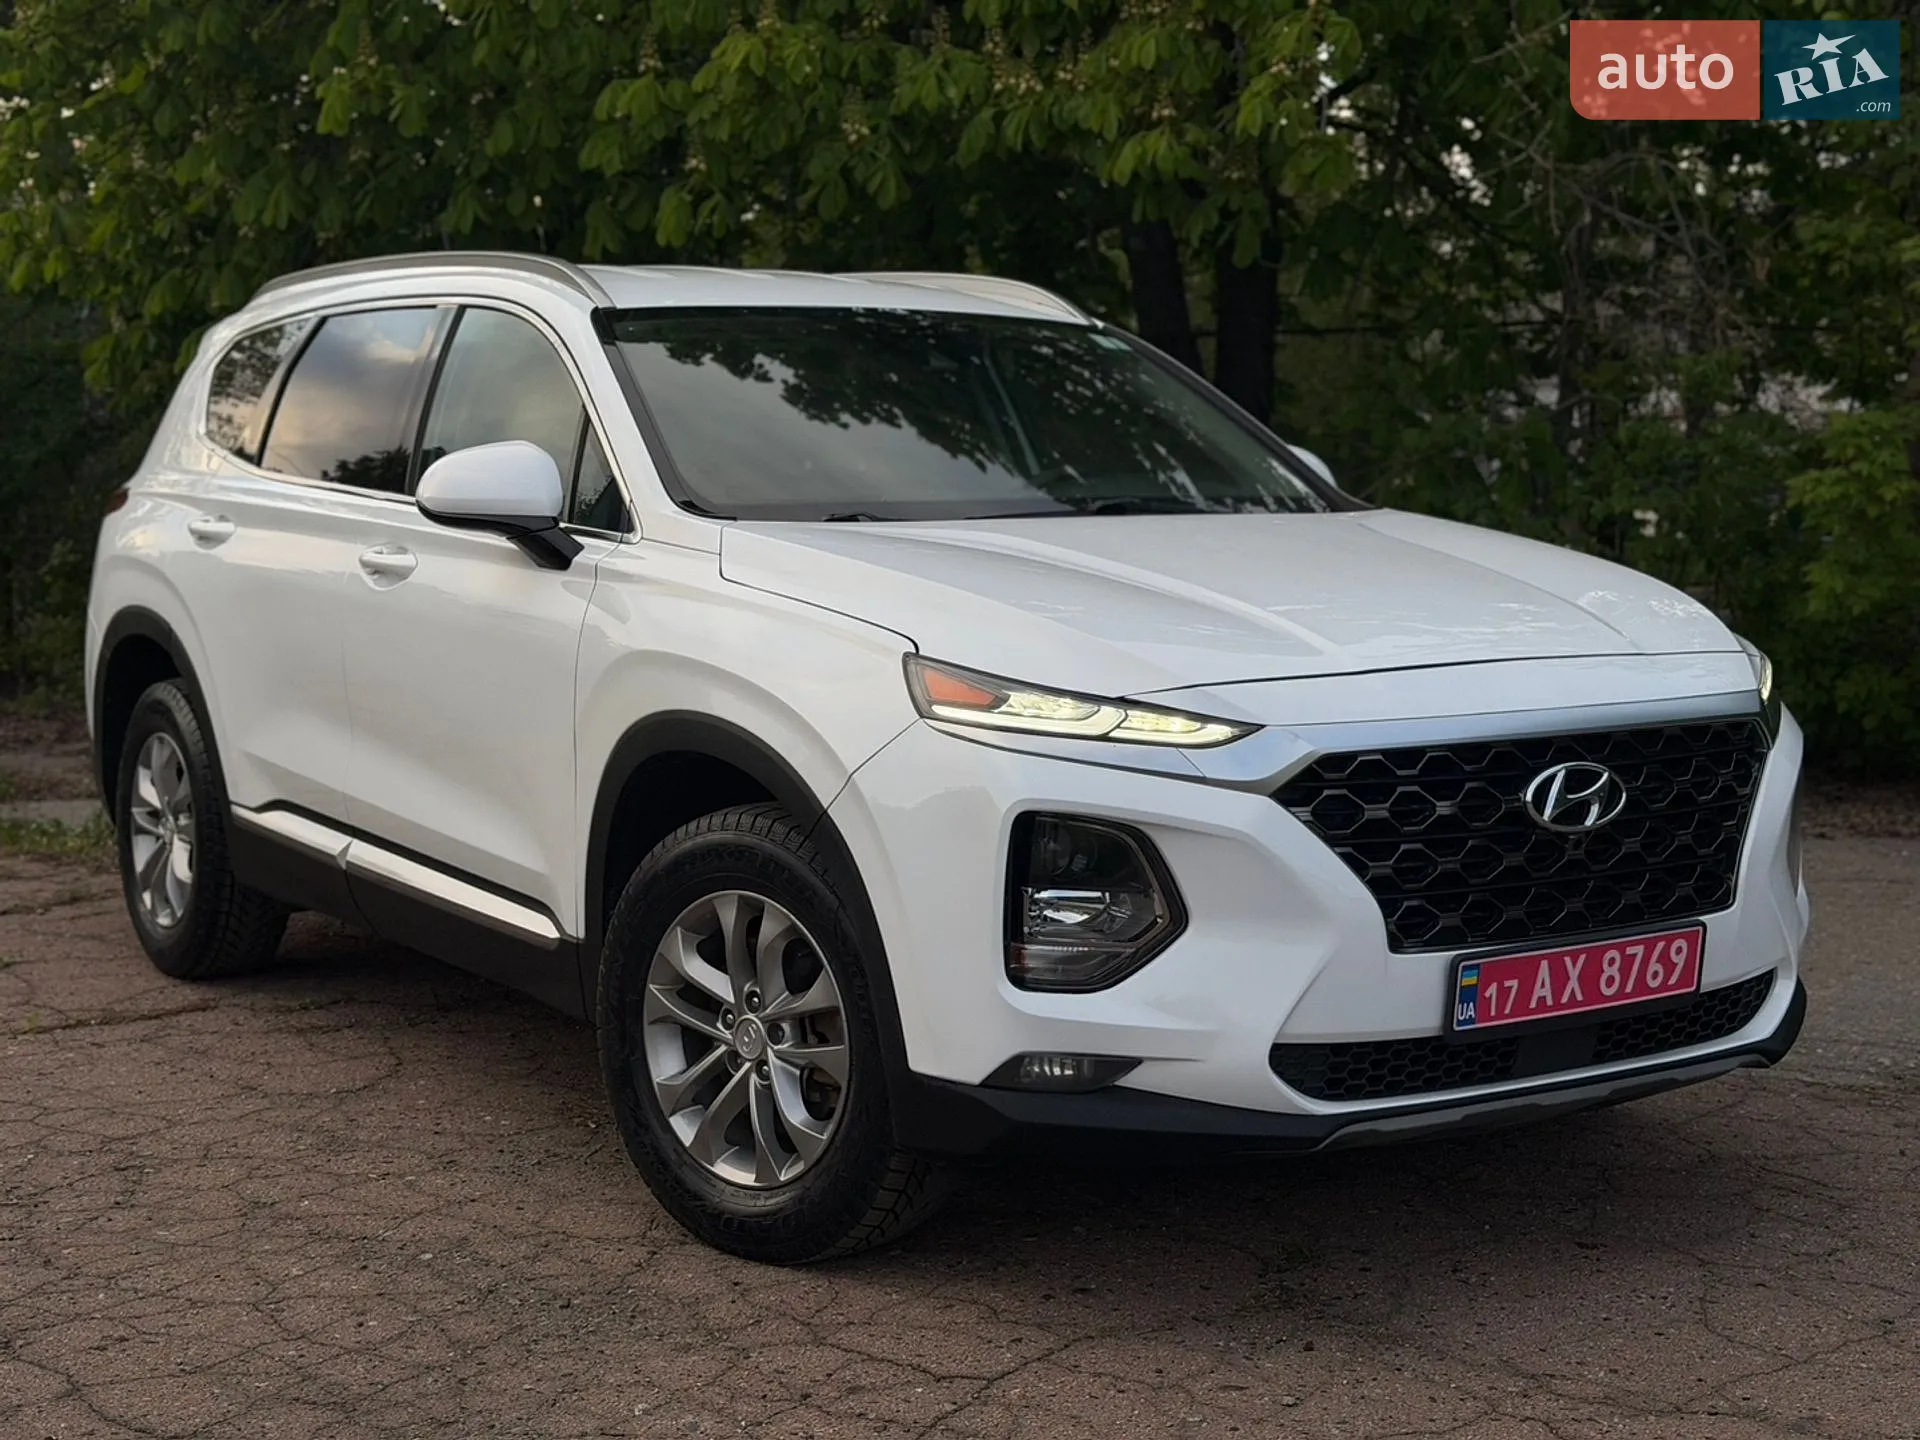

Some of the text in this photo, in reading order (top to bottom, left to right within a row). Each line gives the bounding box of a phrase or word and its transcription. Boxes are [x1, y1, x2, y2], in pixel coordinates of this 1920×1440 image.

[1484, 939, 1688, 1016] 17 AX 8769
[1457, 1001, 1476, 1020] UA
